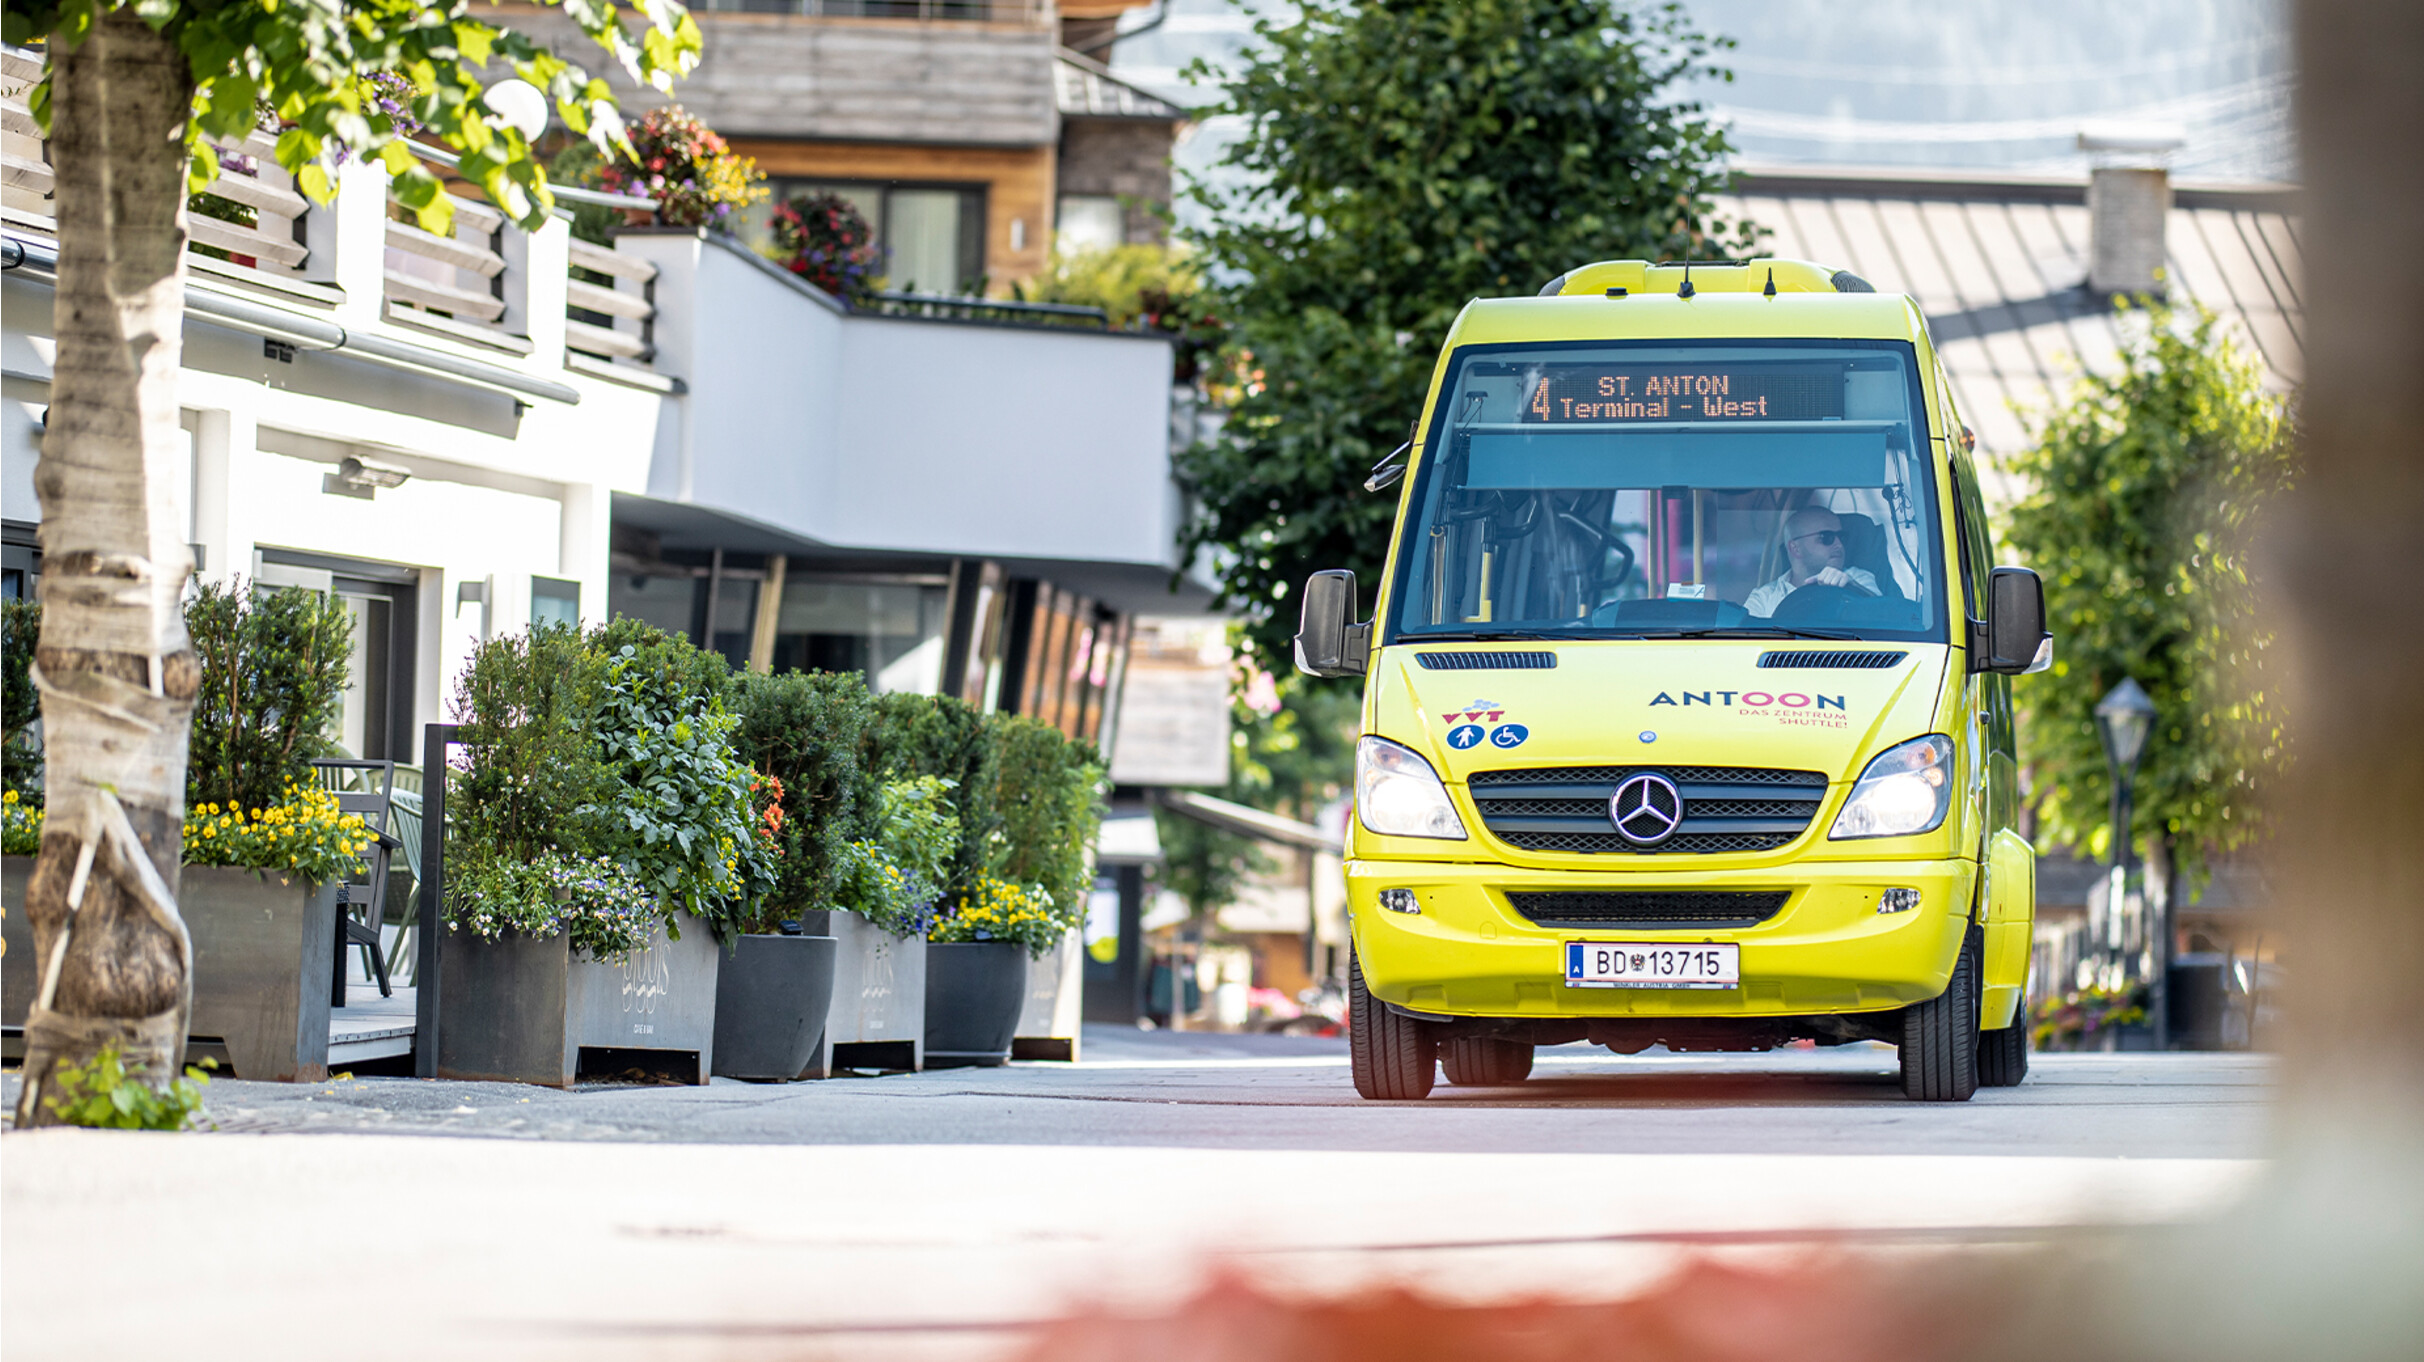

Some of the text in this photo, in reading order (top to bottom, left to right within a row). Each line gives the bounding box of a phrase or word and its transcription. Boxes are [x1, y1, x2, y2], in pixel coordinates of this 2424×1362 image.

[1598, 375, 1728, 396] ST. ANTON
[1532, 377, 1550, 421] 4
[1560, 397, 1669, 419] Terminal
[1703, 396, 1767, 417] West
[1648, 690, 1846, 711] ANTOON
[1441, 710, 1506, 725] VVT
[1739, 709, 1848, 721] DAS ZENTRUM
[1778, 717, 1849, 729] SHUTTLE!
[1572, 965, 1580, 974] A
[1597, 950, 1720, 976] BD 13715
